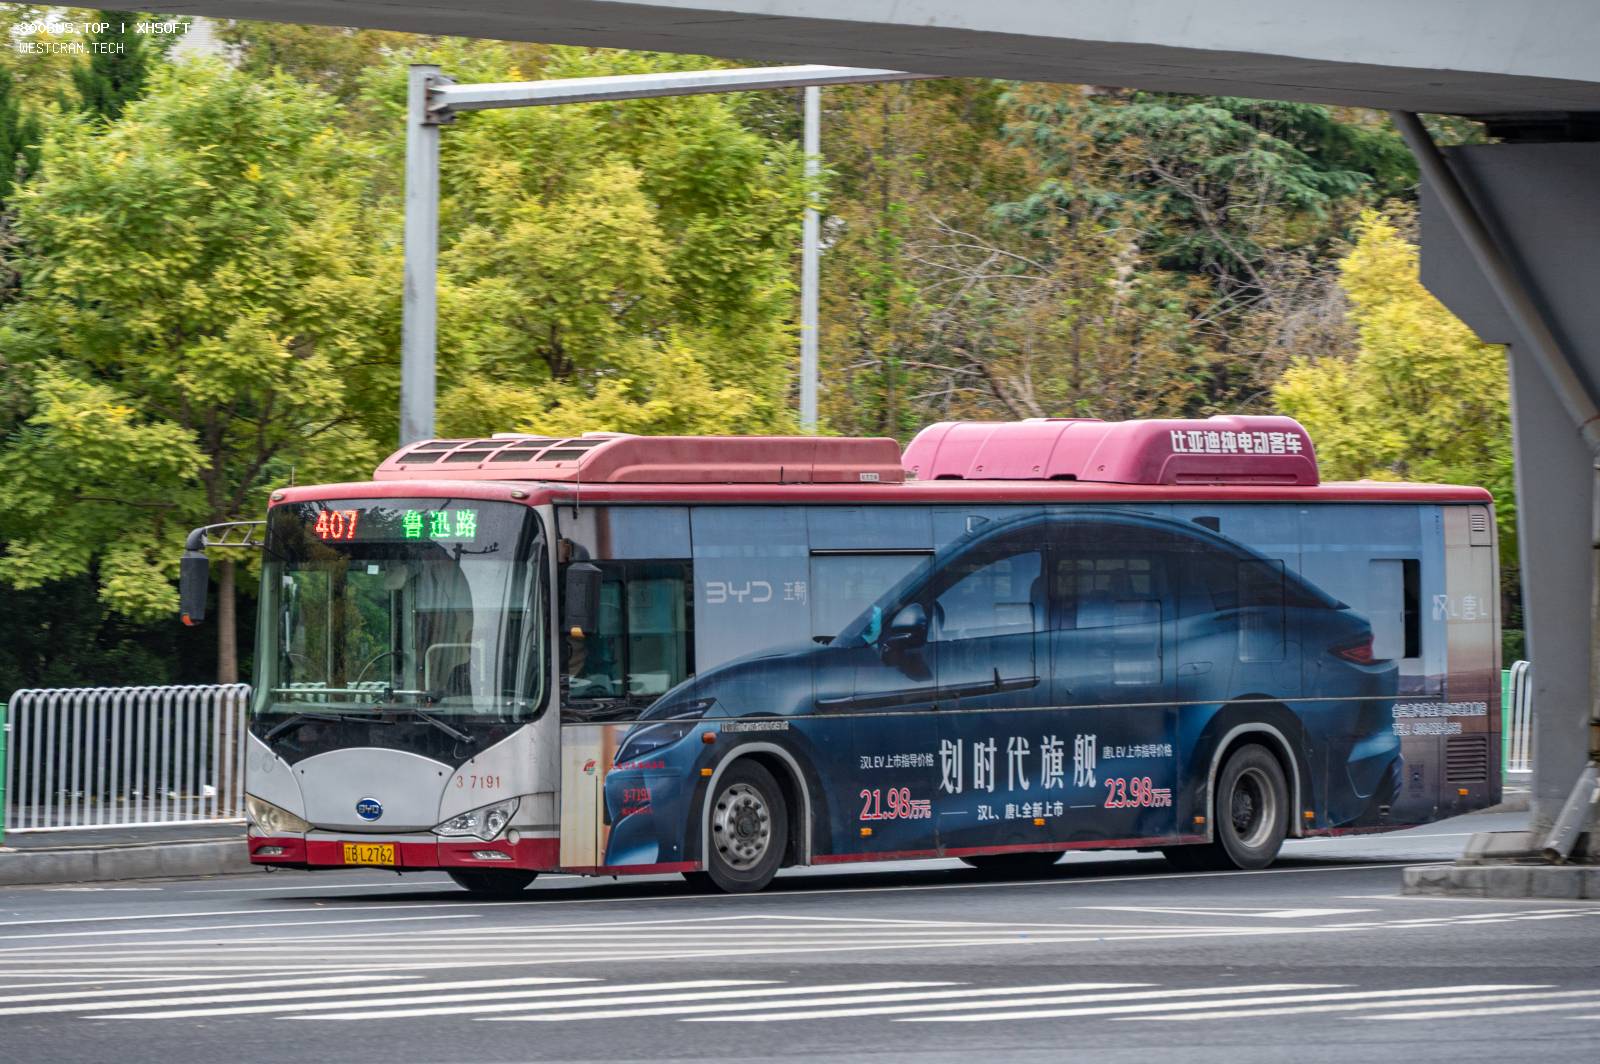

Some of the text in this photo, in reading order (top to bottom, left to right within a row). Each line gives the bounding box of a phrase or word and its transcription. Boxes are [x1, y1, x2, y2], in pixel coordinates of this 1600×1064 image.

[1170, 430, 1303, 454] 比亚迪纯电动客车
[315, 510, 358, 539] 407
[402, 509, 477, 539] 鲁迅路
[706, 581, 773, 603] BYD
[938, 733, 1097, 794] 划时代旗舰
